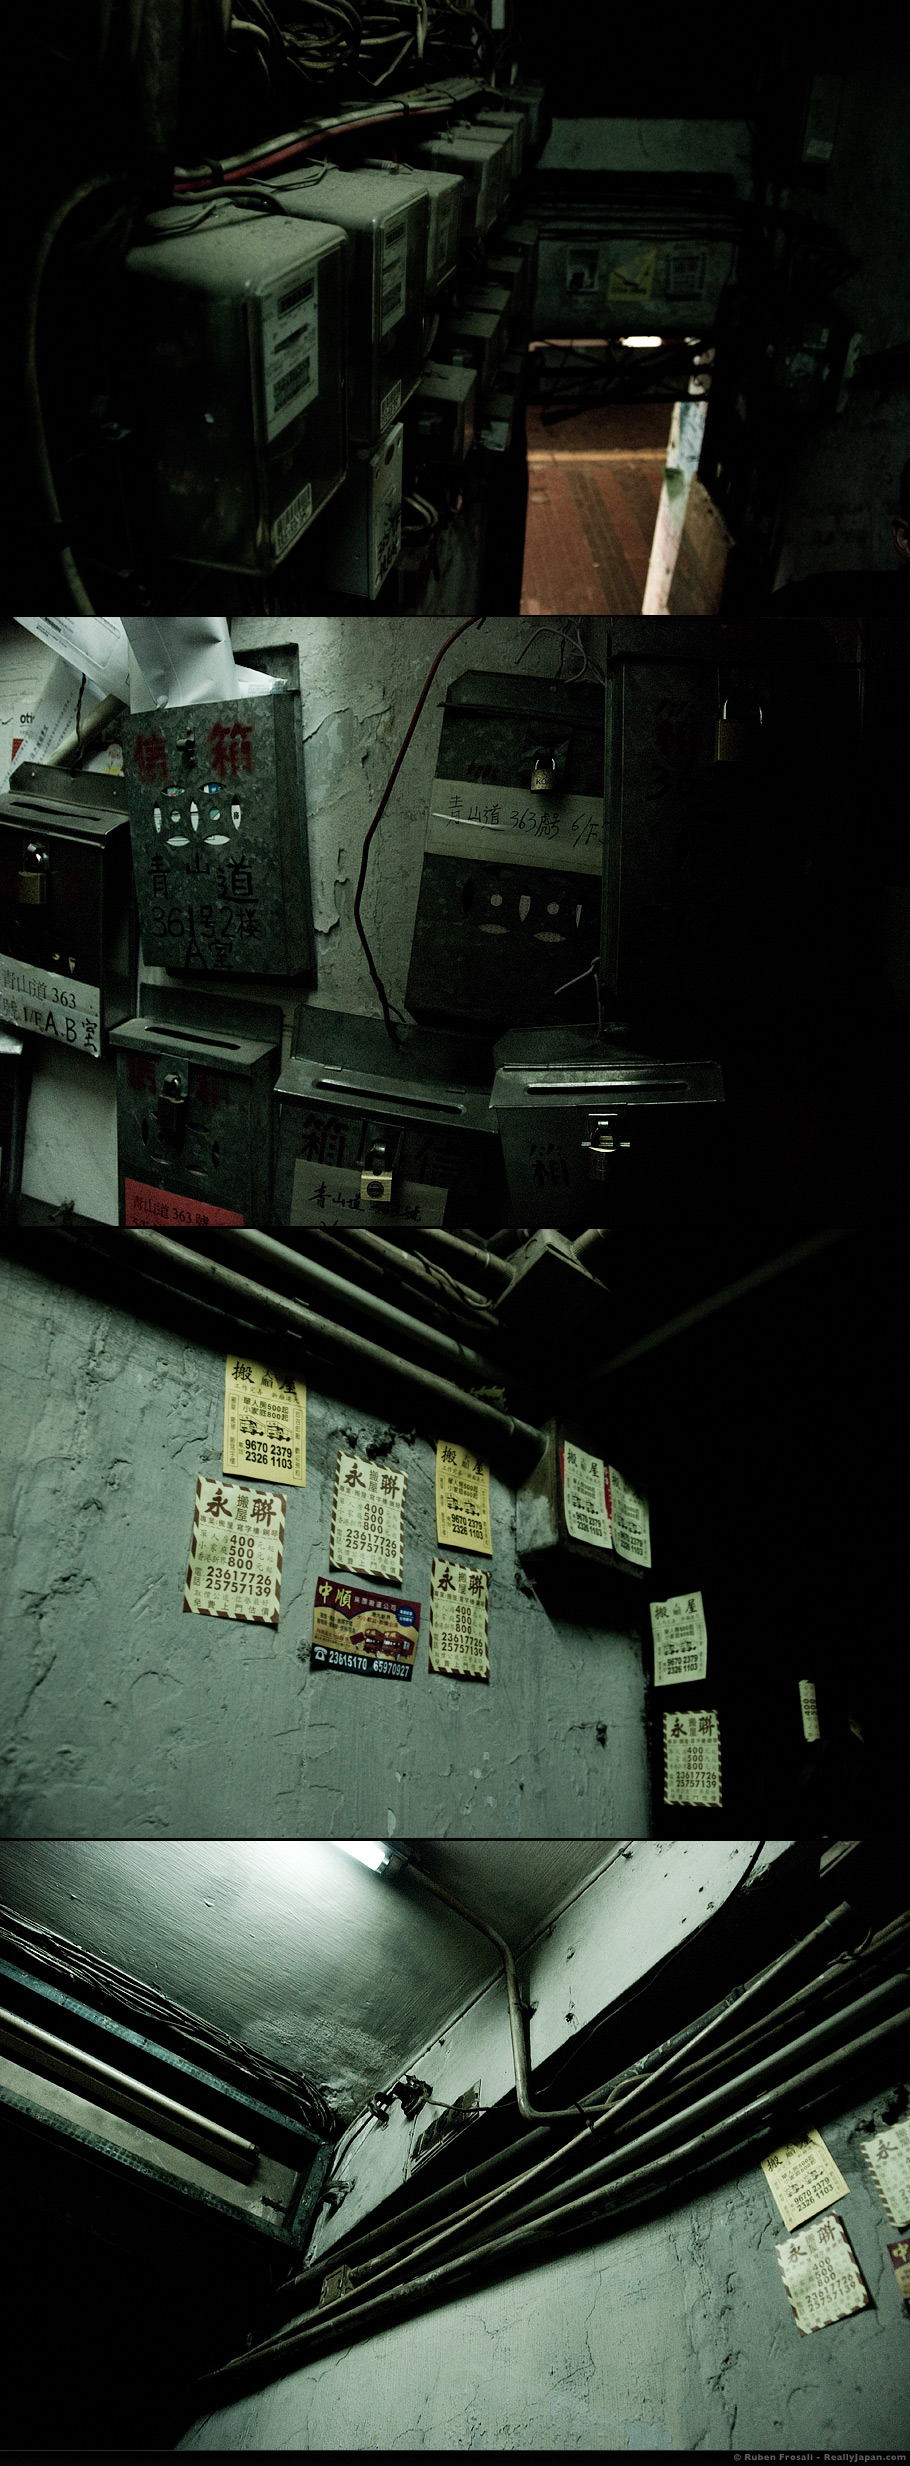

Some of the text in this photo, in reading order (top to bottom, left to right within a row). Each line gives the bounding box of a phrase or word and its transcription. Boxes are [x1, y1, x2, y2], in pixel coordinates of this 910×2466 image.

[149, 852, 258, 903] 青山道
[185, 938, 233, 969] A室
[52, 987, 76, 1009] 363
[172, 1207, 192, 1223] 363
[245, 1439, 292, 1458] 9670 2379
[245, 1451, 293, 1470] 2326 1103
[343, 1463, 366, 1488] 永
[380, 1474, 400, 1499] 聯
[204, 1488, 277, 1527] 永 搬屋 聯
[364, 1503, 384, 1516] 400
[364, 1512, 384, 1525] 500
[451, 1514, 483, 1530] 9670 2379
[363, 1521, 383, 1534] 800
[452, 1524, 484, 1540] 2326 1103
[230, 1534, 255, 1548] 400
[346, 1529, 397, 1549] 23617726
[229, 1545, 254, 1559] 500
[345, 1539, 397, 1559] 25757139
[227, 1556, 253, 1570] 800
[207, 1566, 272, 1586] 23617726
[437, 1566, 456, 1592] 永
[468, 1575, 484, 1598] 聯
[205, 1578, 271, 1598] 25757139
[318, 1581, 352, 1610] 中順
[456, 1605, 471, 1616] 400
[456, 1615, 472, 1625] 500
[456, 1623, 472, 1634] 800
[442, 1632, 483, 1648] 23617726
[441, 1642, 483, 1657] 25757139
[329, 1651, 410, 1678] 23615170 65970927
[670, 1717, 687, 1738] 永
[676, 1772, 717, 1780] 23617726
[794, 2176, 830, 2204] 9670 2379
[797, 2184, 834, 2212] 2326 1103
[812, 2257, 831, 2271] 400
[815, 2264, 833, 2280] 500
